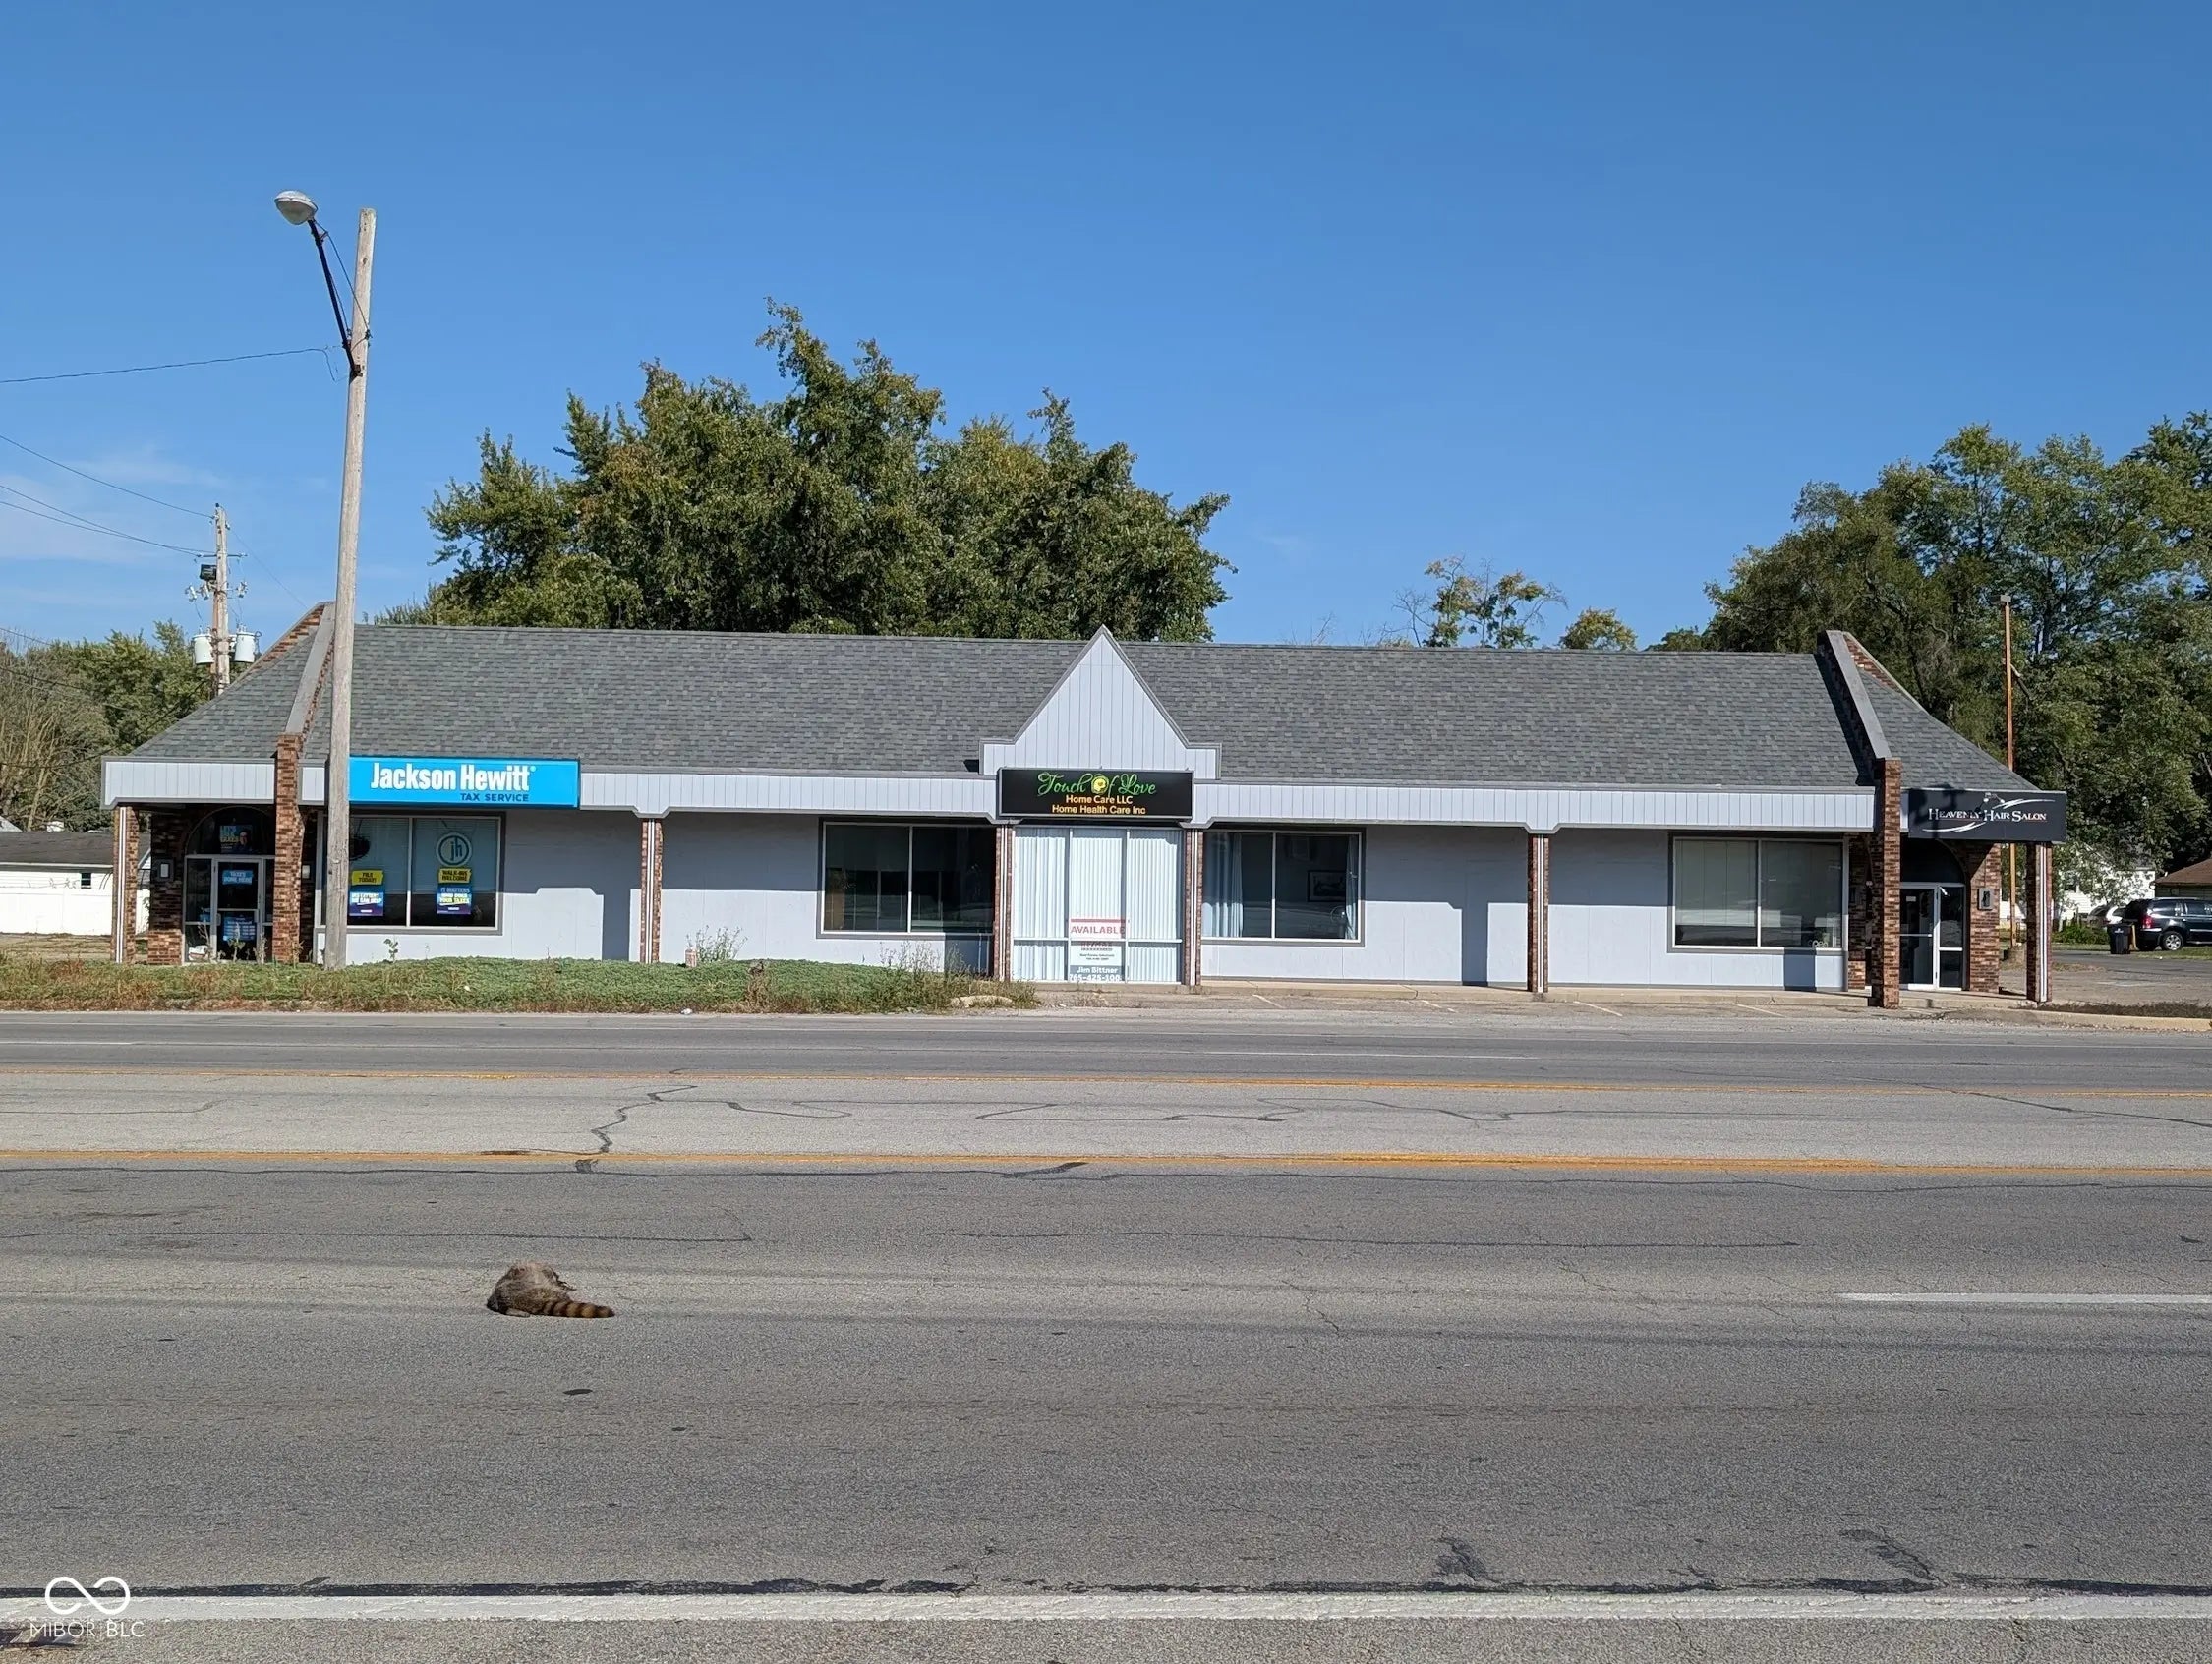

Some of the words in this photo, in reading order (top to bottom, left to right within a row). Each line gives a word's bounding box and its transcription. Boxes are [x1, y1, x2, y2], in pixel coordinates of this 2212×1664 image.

[371, 762, 456, 791] Jackson
[460, 764, 531, 791] Hewitt
[1037, 772, 1093, 797] Touch
[1118, 774, 1156, 796] Love
[460, 792, 481, 802] TAX
[485, 793, 530, 803] SERVICE
[1066, 794, 1092, 804] Home
[1093, 795, 1115, 804] Care
[1117, 795, 1134, 805] LLC
[1052, 805, 1077, 814] Home
[1080, 805, 1108, 814] Health
[1109, 806, 1131, 815] Care
[1133, 806, 1146, 815] Inc
[1984, 809, 2010, 822] HAIR
[2011, 810, 2047, 822] SALON
[1071, 926, 1125, 935] AVAILABLE
